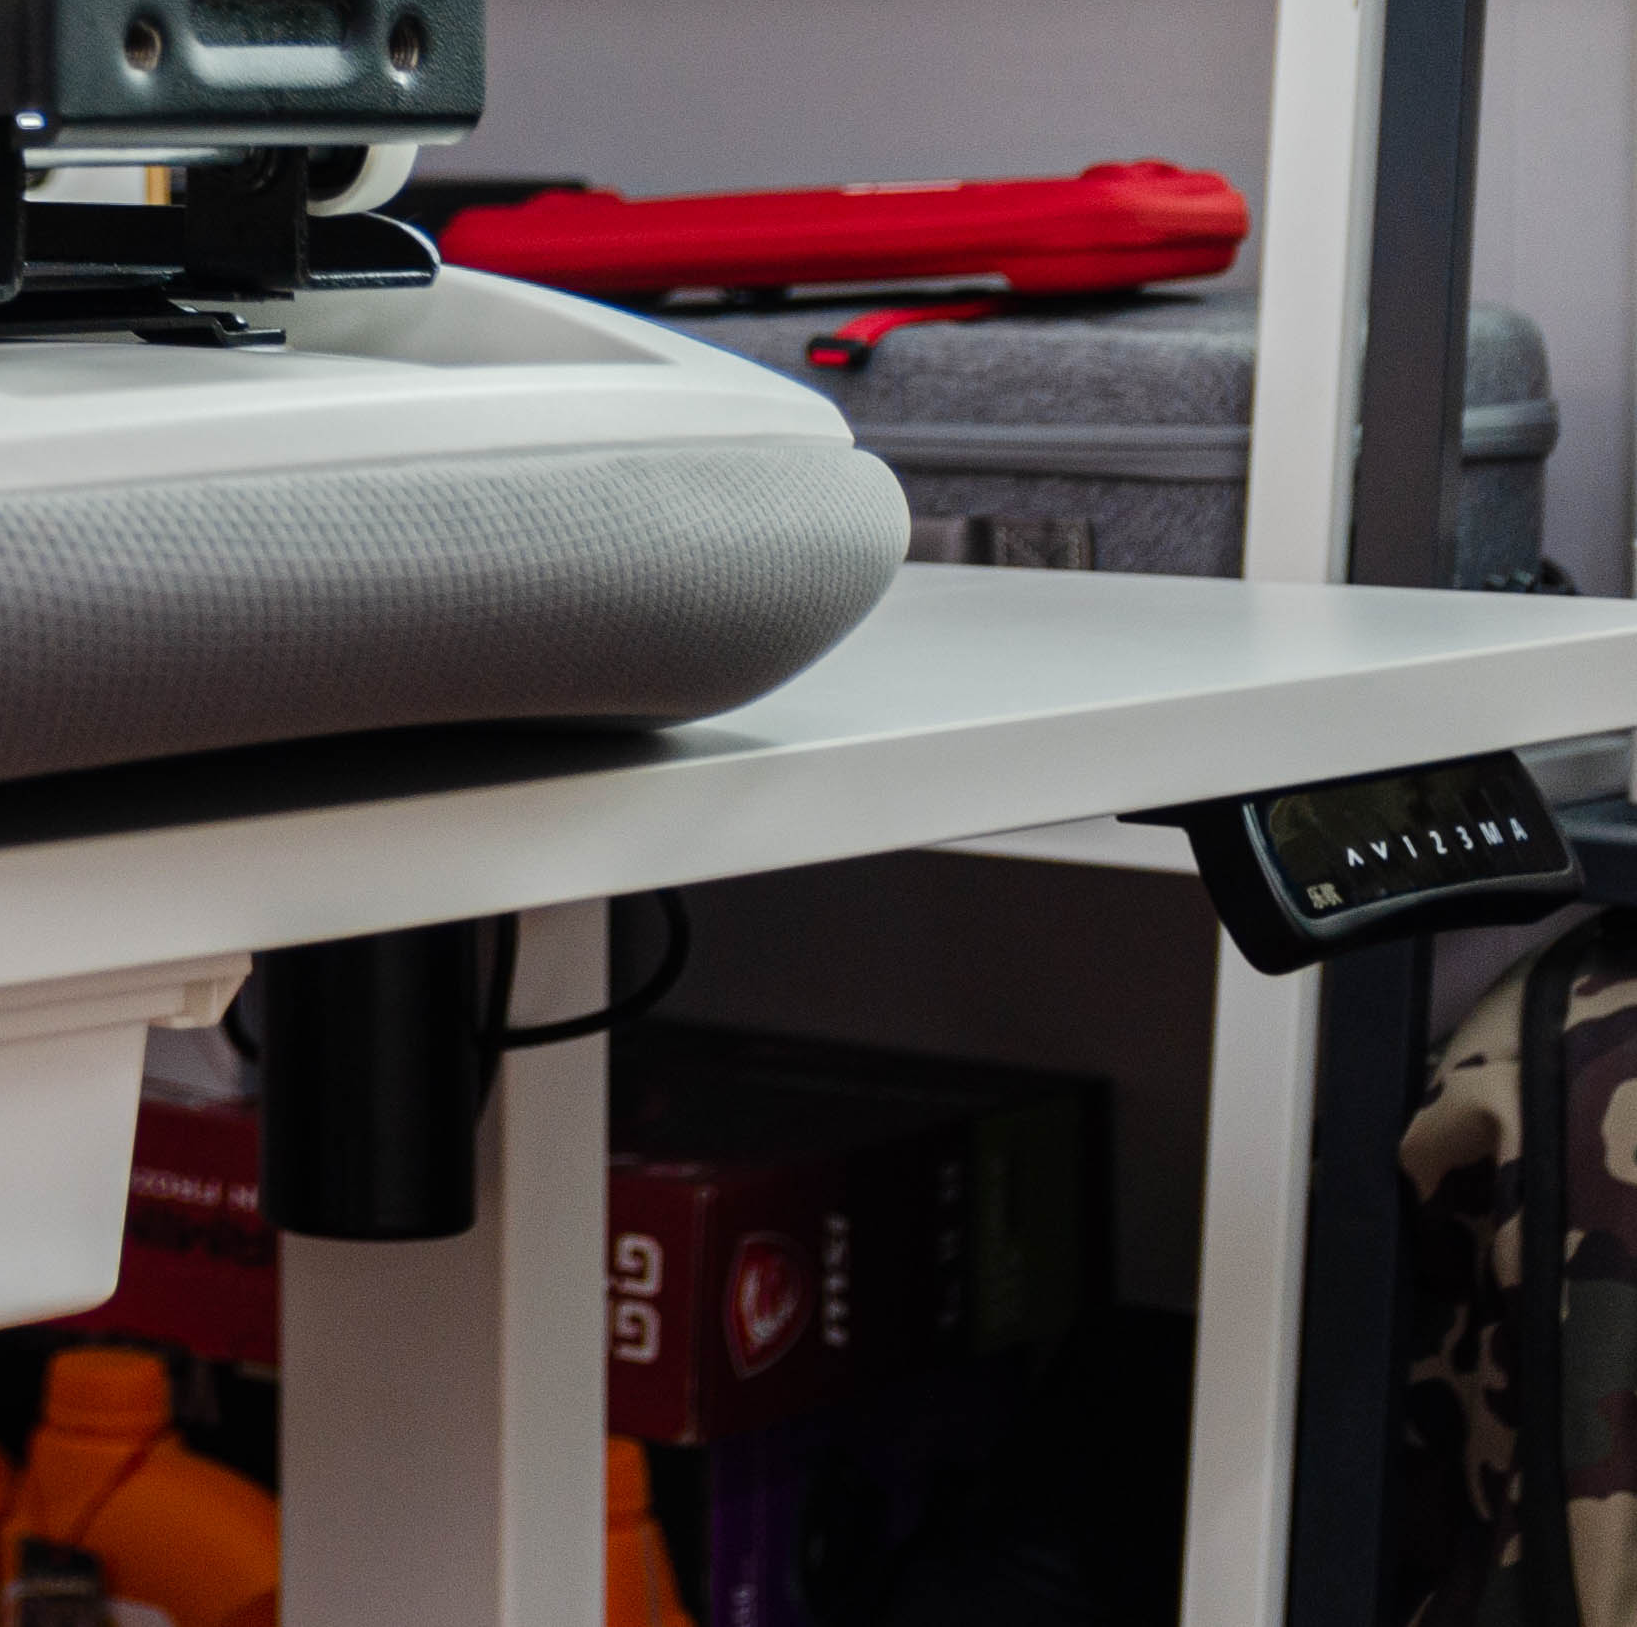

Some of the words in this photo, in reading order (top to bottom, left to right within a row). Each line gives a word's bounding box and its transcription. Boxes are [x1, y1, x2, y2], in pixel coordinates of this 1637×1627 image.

[1403, 836, 1418, 858] 1
[1430, 830, 1448, 855] 2
[1457, 826, 1474, 850] 3
[1480, 821, 1504, 846] M
[1510, 817, 1528, 841] A
